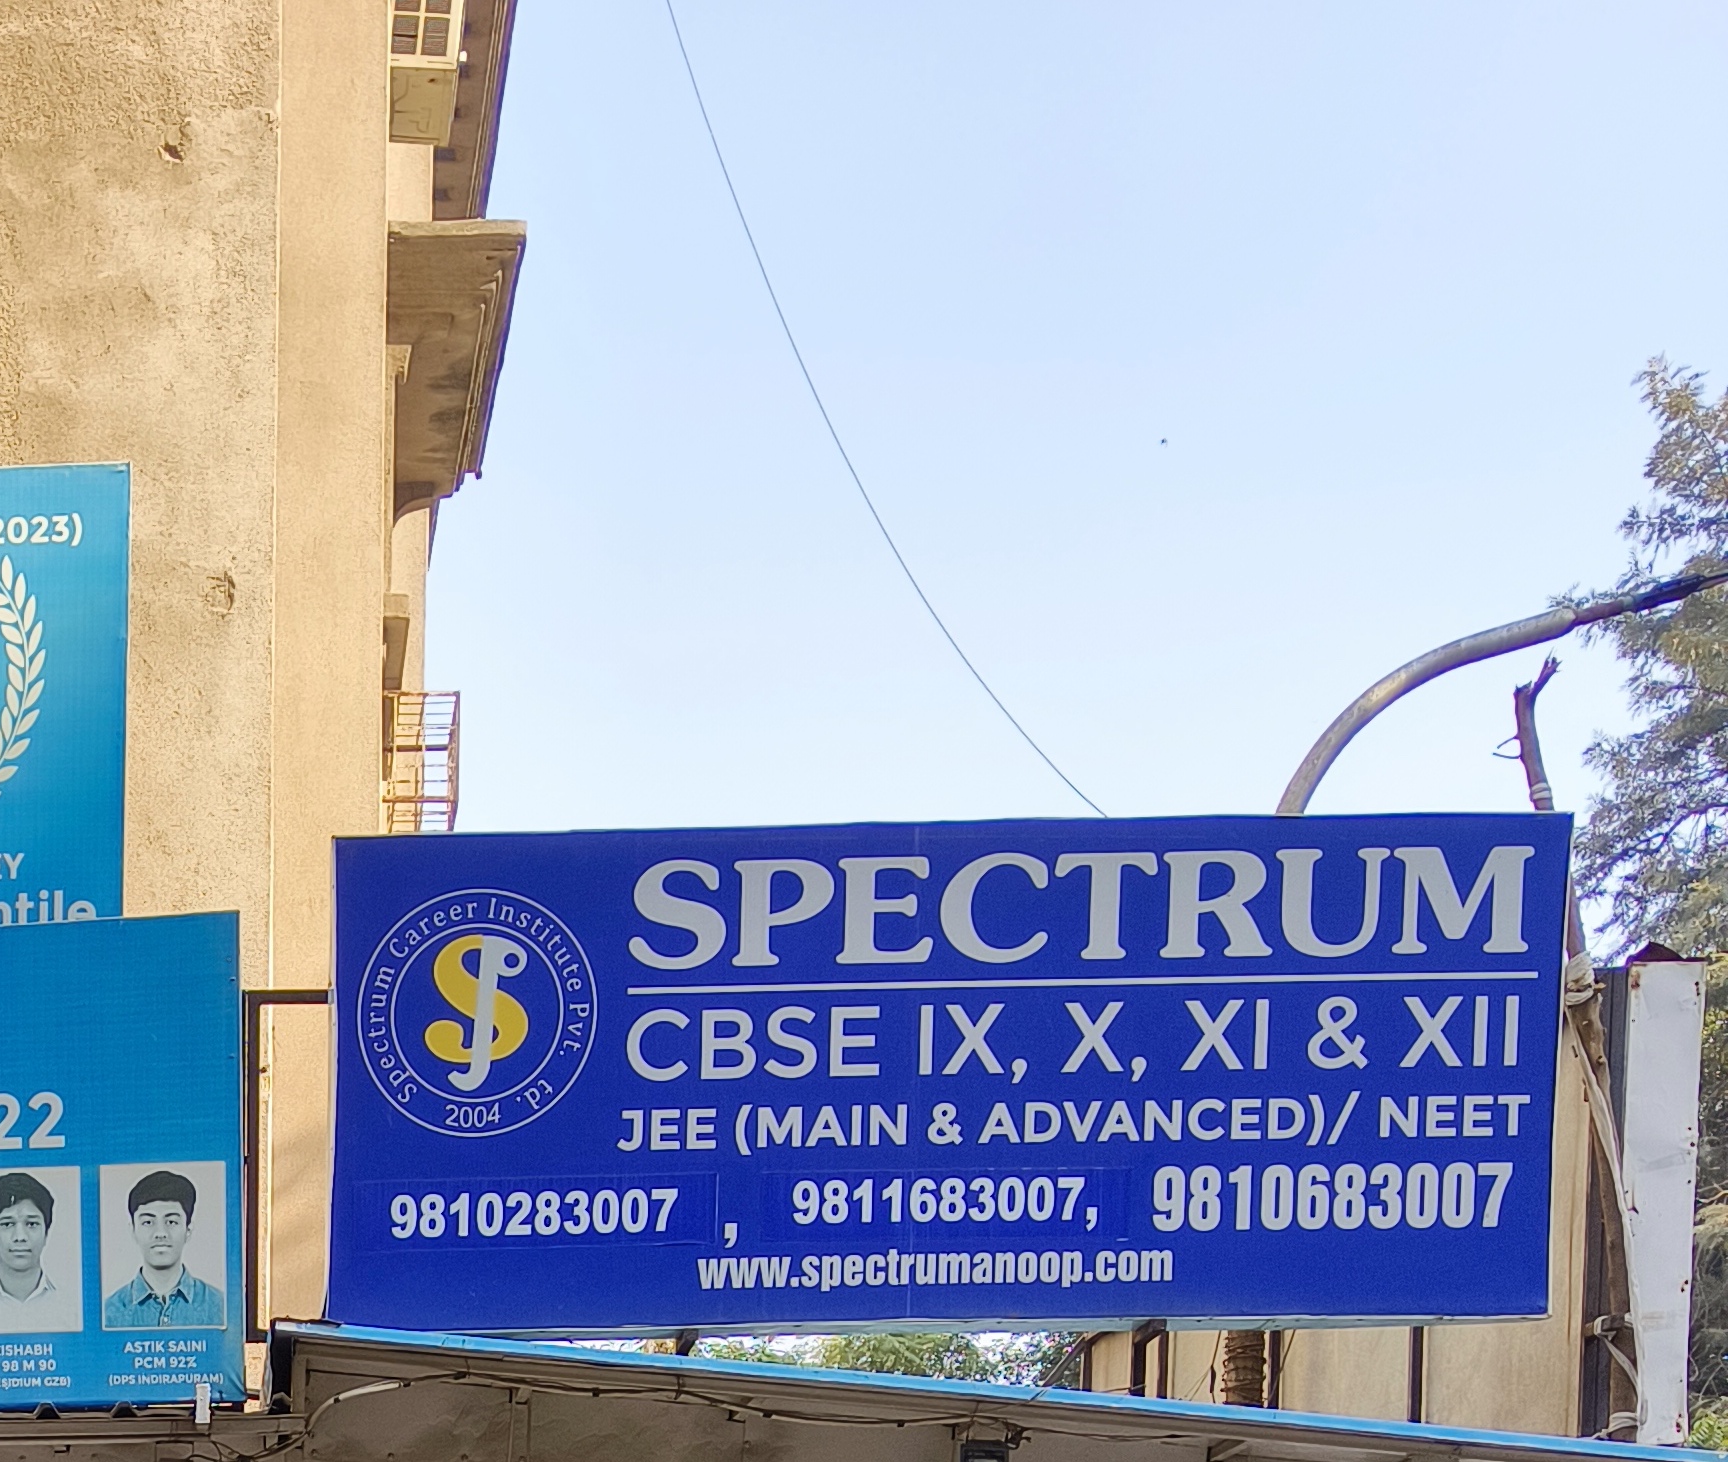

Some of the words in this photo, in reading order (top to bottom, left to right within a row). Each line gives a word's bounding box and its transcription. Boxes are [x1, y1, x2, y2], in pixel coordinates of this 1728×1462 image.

[389, 902, 477, 958] Career
[627, 846, 1535, 969] SPECTRUM
[488, 898, 582, 992] Institute
[368, 966, 417, 1103] Spectrum
[559, 1003, 590, 1056] Pvt.
[625, 1004, 881, 1081] CBSE
[918, 1002, 1029, 1081] IX,
[1060, 1001, 1147, 1080] X,
[1180, 999, 1273, 1071] XI
[1306, 995, 1365, 1069] &
[1399, 994, 1521, 1068] XII
[445, 1103, 501, 1128] 2004
[617, 1106, 718, 1151] JEE
[733, 1103, 905, 1156] (MAIN
[926, 1103, 962, 1146] &
[978, 1090, 1359, 1146] ADVANCED)/
[1379, 1095, 1531, 1139] NEET
[389, 1188, 678, 1239] 9810283007
[791, 1176, 1100, 1231] 9811683007,
[1152, 1161, 1513, 1231] 9810683007
[698, 1249, 1174, 1290] www.spectrumanoop.com
[124, 1341, 164, 1354] ASTIK
[168, 1341, 206, 1353] SAINI
